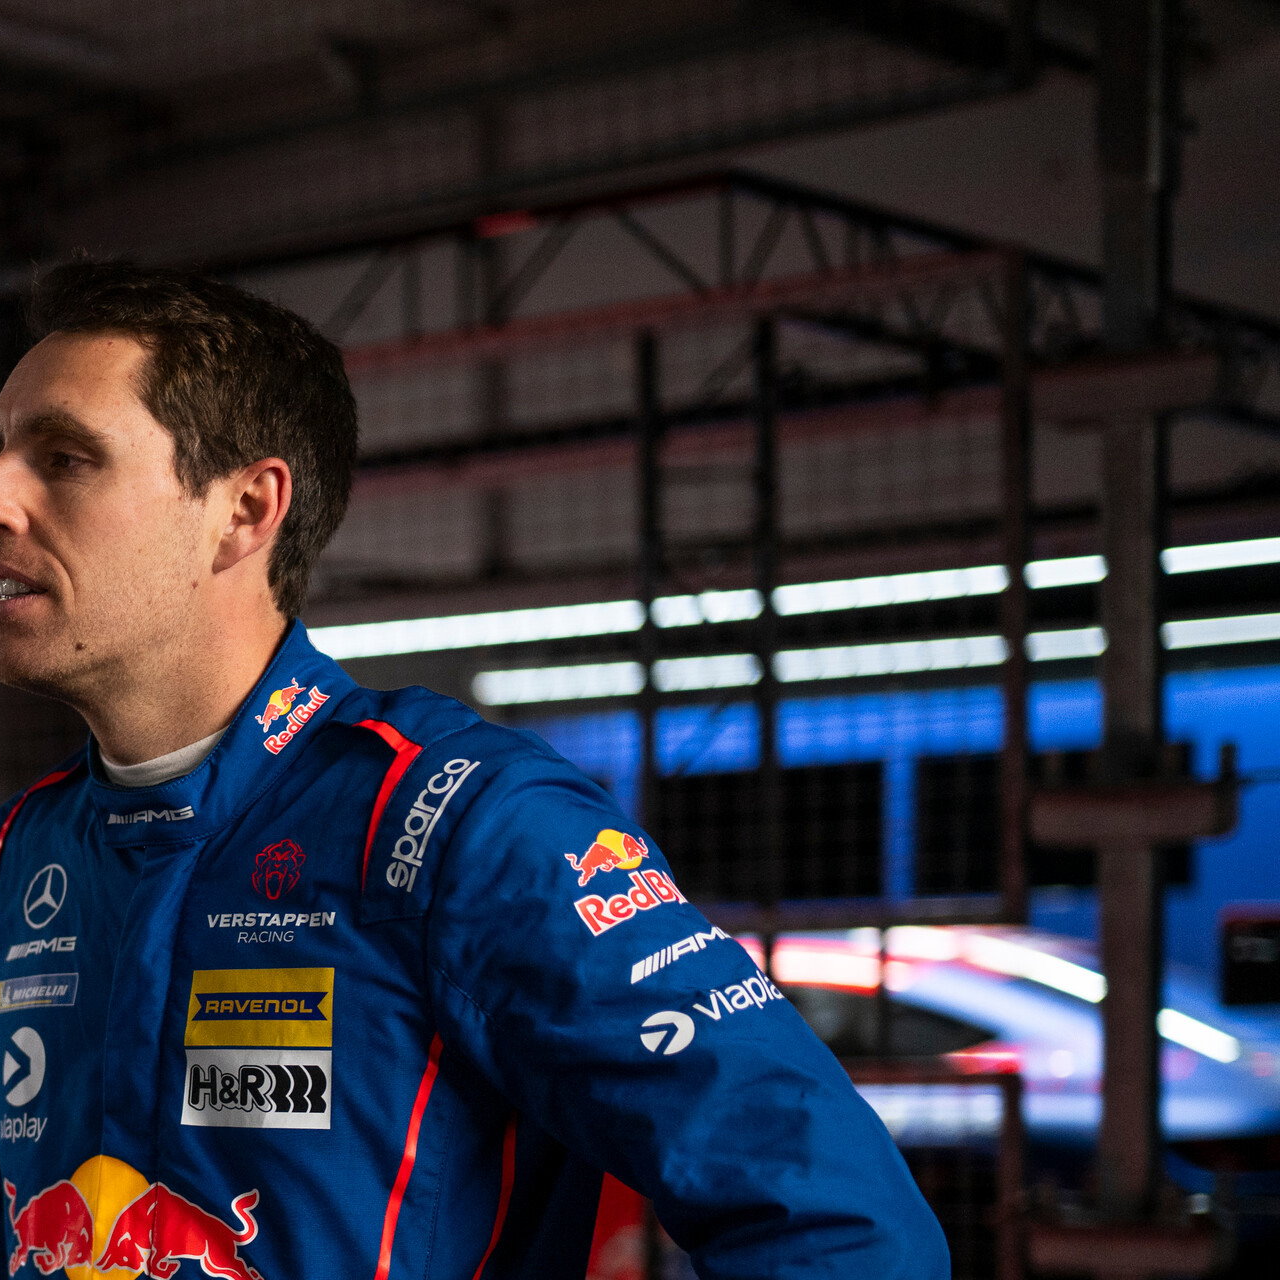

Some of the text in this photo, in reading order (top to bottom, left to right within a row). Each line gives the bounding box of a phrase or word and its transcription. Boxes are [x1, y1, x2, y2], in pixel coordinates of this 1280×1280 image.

[263, 686, 331, 755] Red Bull
[131, 806, 195, 824] AMG
[386, 758, 475, 892] sparco
[574, 871, 662, 937] Red
[207, 911, 336, 929] VERSTAPPEN
[24, 936, 77, 955] AMG
[237, 930, 295, 944] RACING
[11, 983, 69, 1000] MICHELIN
[692, 969, 786, 1021] viapla
[204, 999, 314, 1014] RAVENOL
[188, 1063, 274, 1112] H&R
